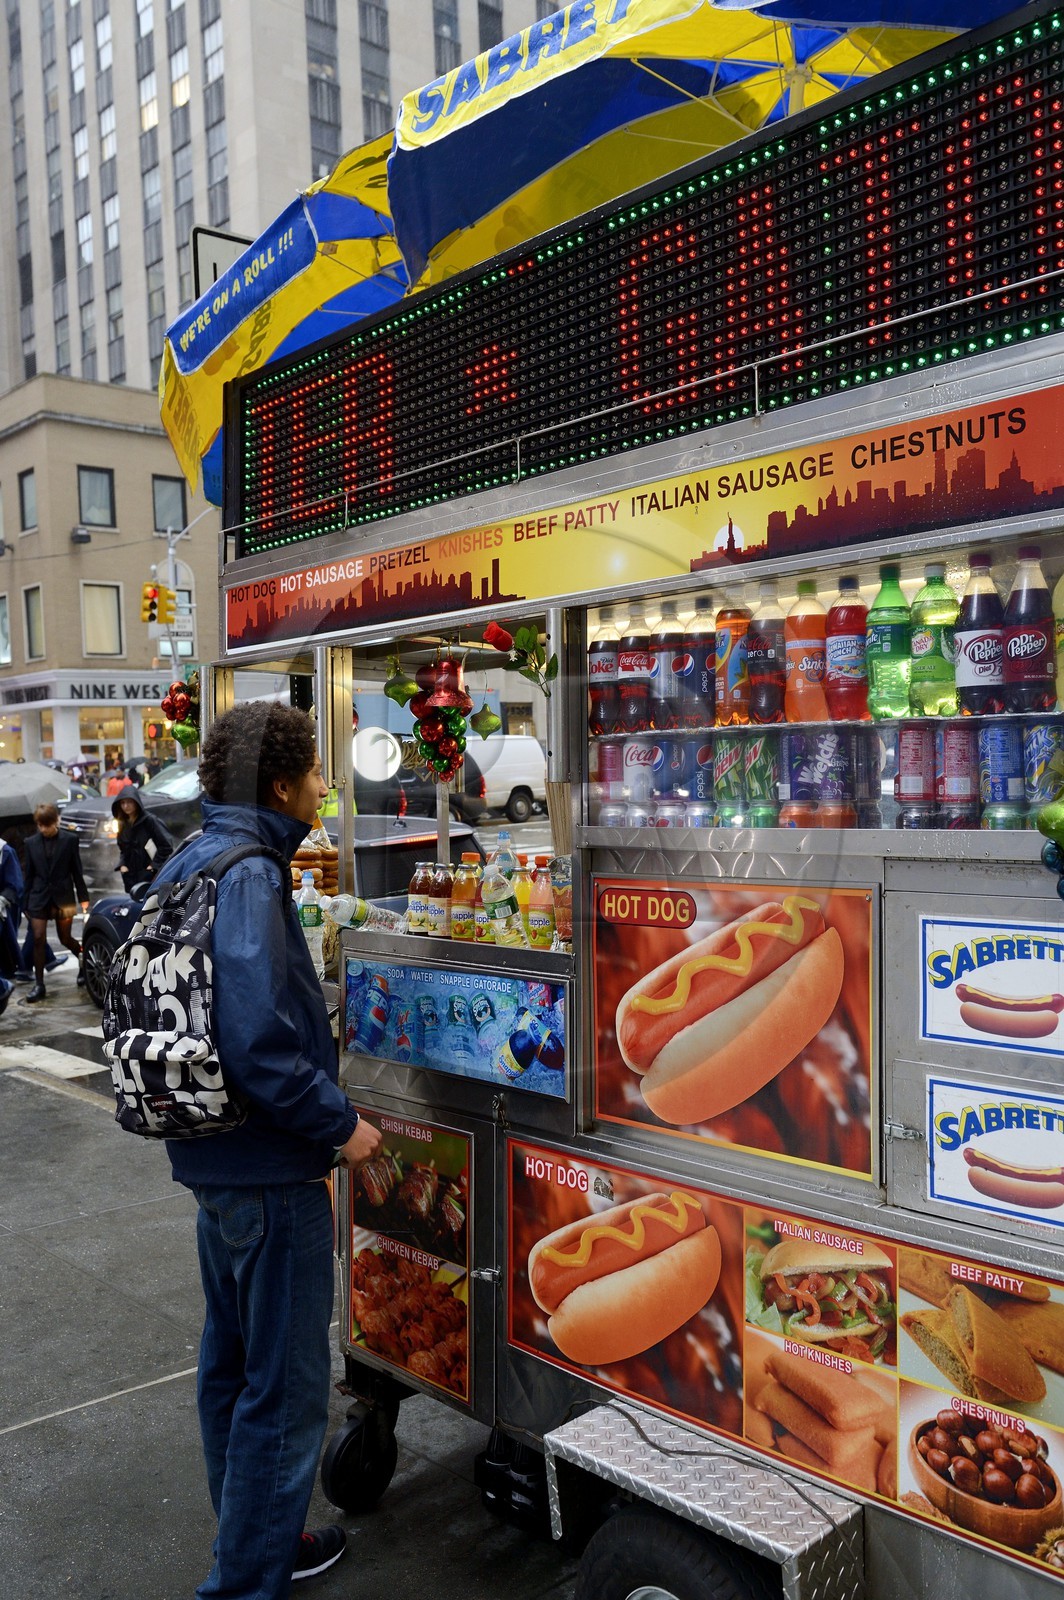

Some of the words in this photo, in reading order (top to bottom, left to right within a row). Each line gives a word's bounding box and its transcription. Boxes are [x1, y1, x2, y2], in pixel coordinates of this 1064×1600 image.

[179, 306, 212, 353] WE'RE
[212, 288, 229, 315] ON
[232, 278, 241, 297] A
[243, 247, 275, 287] ROLL
[278, 227, 294, 255] !!!
[230, 586, 251, 605] HOT
[253, 580, 277, 599] DOG
[280, 573, 304, 594] HOT
[305, 559, 363, 588] SAUSAGE
[369, 545, 430, 574] PRETZEL
[438, 527, 504, 559] KNISHES
[514, 514, 558, 542] BEEF
[564, 499, 620, 531] PATTY
[631, 480, 710, 517] ITALIAN
[717, 452, 834, 498] SAUSAGE
[850, 407, 1027, 469] CHESTNUTS
[984, 638, 998, 650] Dr
[1009, 637, 1045, 658] Pepper
[1019, 633, 1035, 646] Dr
[590, 660, 614, 675] oke
[978, 664, 992, 674] Diet
[70, 684, 117, 699] NINE
[123, 684, 169, 699] WES
[696, 771, 706, 799] pepsi
[452, 910, 475, 922] napple
[604, 894, 642, 919] HOT
[647, 896, 690, 923] DOG
[928, 934, 1064, 989] SABRETT
[387, 968, 405, 979] SODA
[411, 970, 434, 983] WATER
[440, 974, 471, 988] SNAPPLE
[473, 978, 512, 993] GATORADE
[380, 1118, 404, 1135] SHISH
[405, 1124, 433, 1143] KEBAB
[525, 1156, 553, 1181] HOT
[557, 1165, 588, 1192] DOG
[774, 1220, 811, 1241] ITALIAN
[813, 1231, 863, 1255] SAUSAGE
[377, 1236, 410, 1260] CHICKEN
[412, 1249, 439, 1271] KEBAB
[951, 1263, 982, 1282] BEEF
[985, 1271, 1025, 1293] PATTY
[784, 1339, 806, 1356] HOT
[807, 1350, 852, 1374] KNISHES
[951, 1396, 1026, 1433] CHESTNUTS
